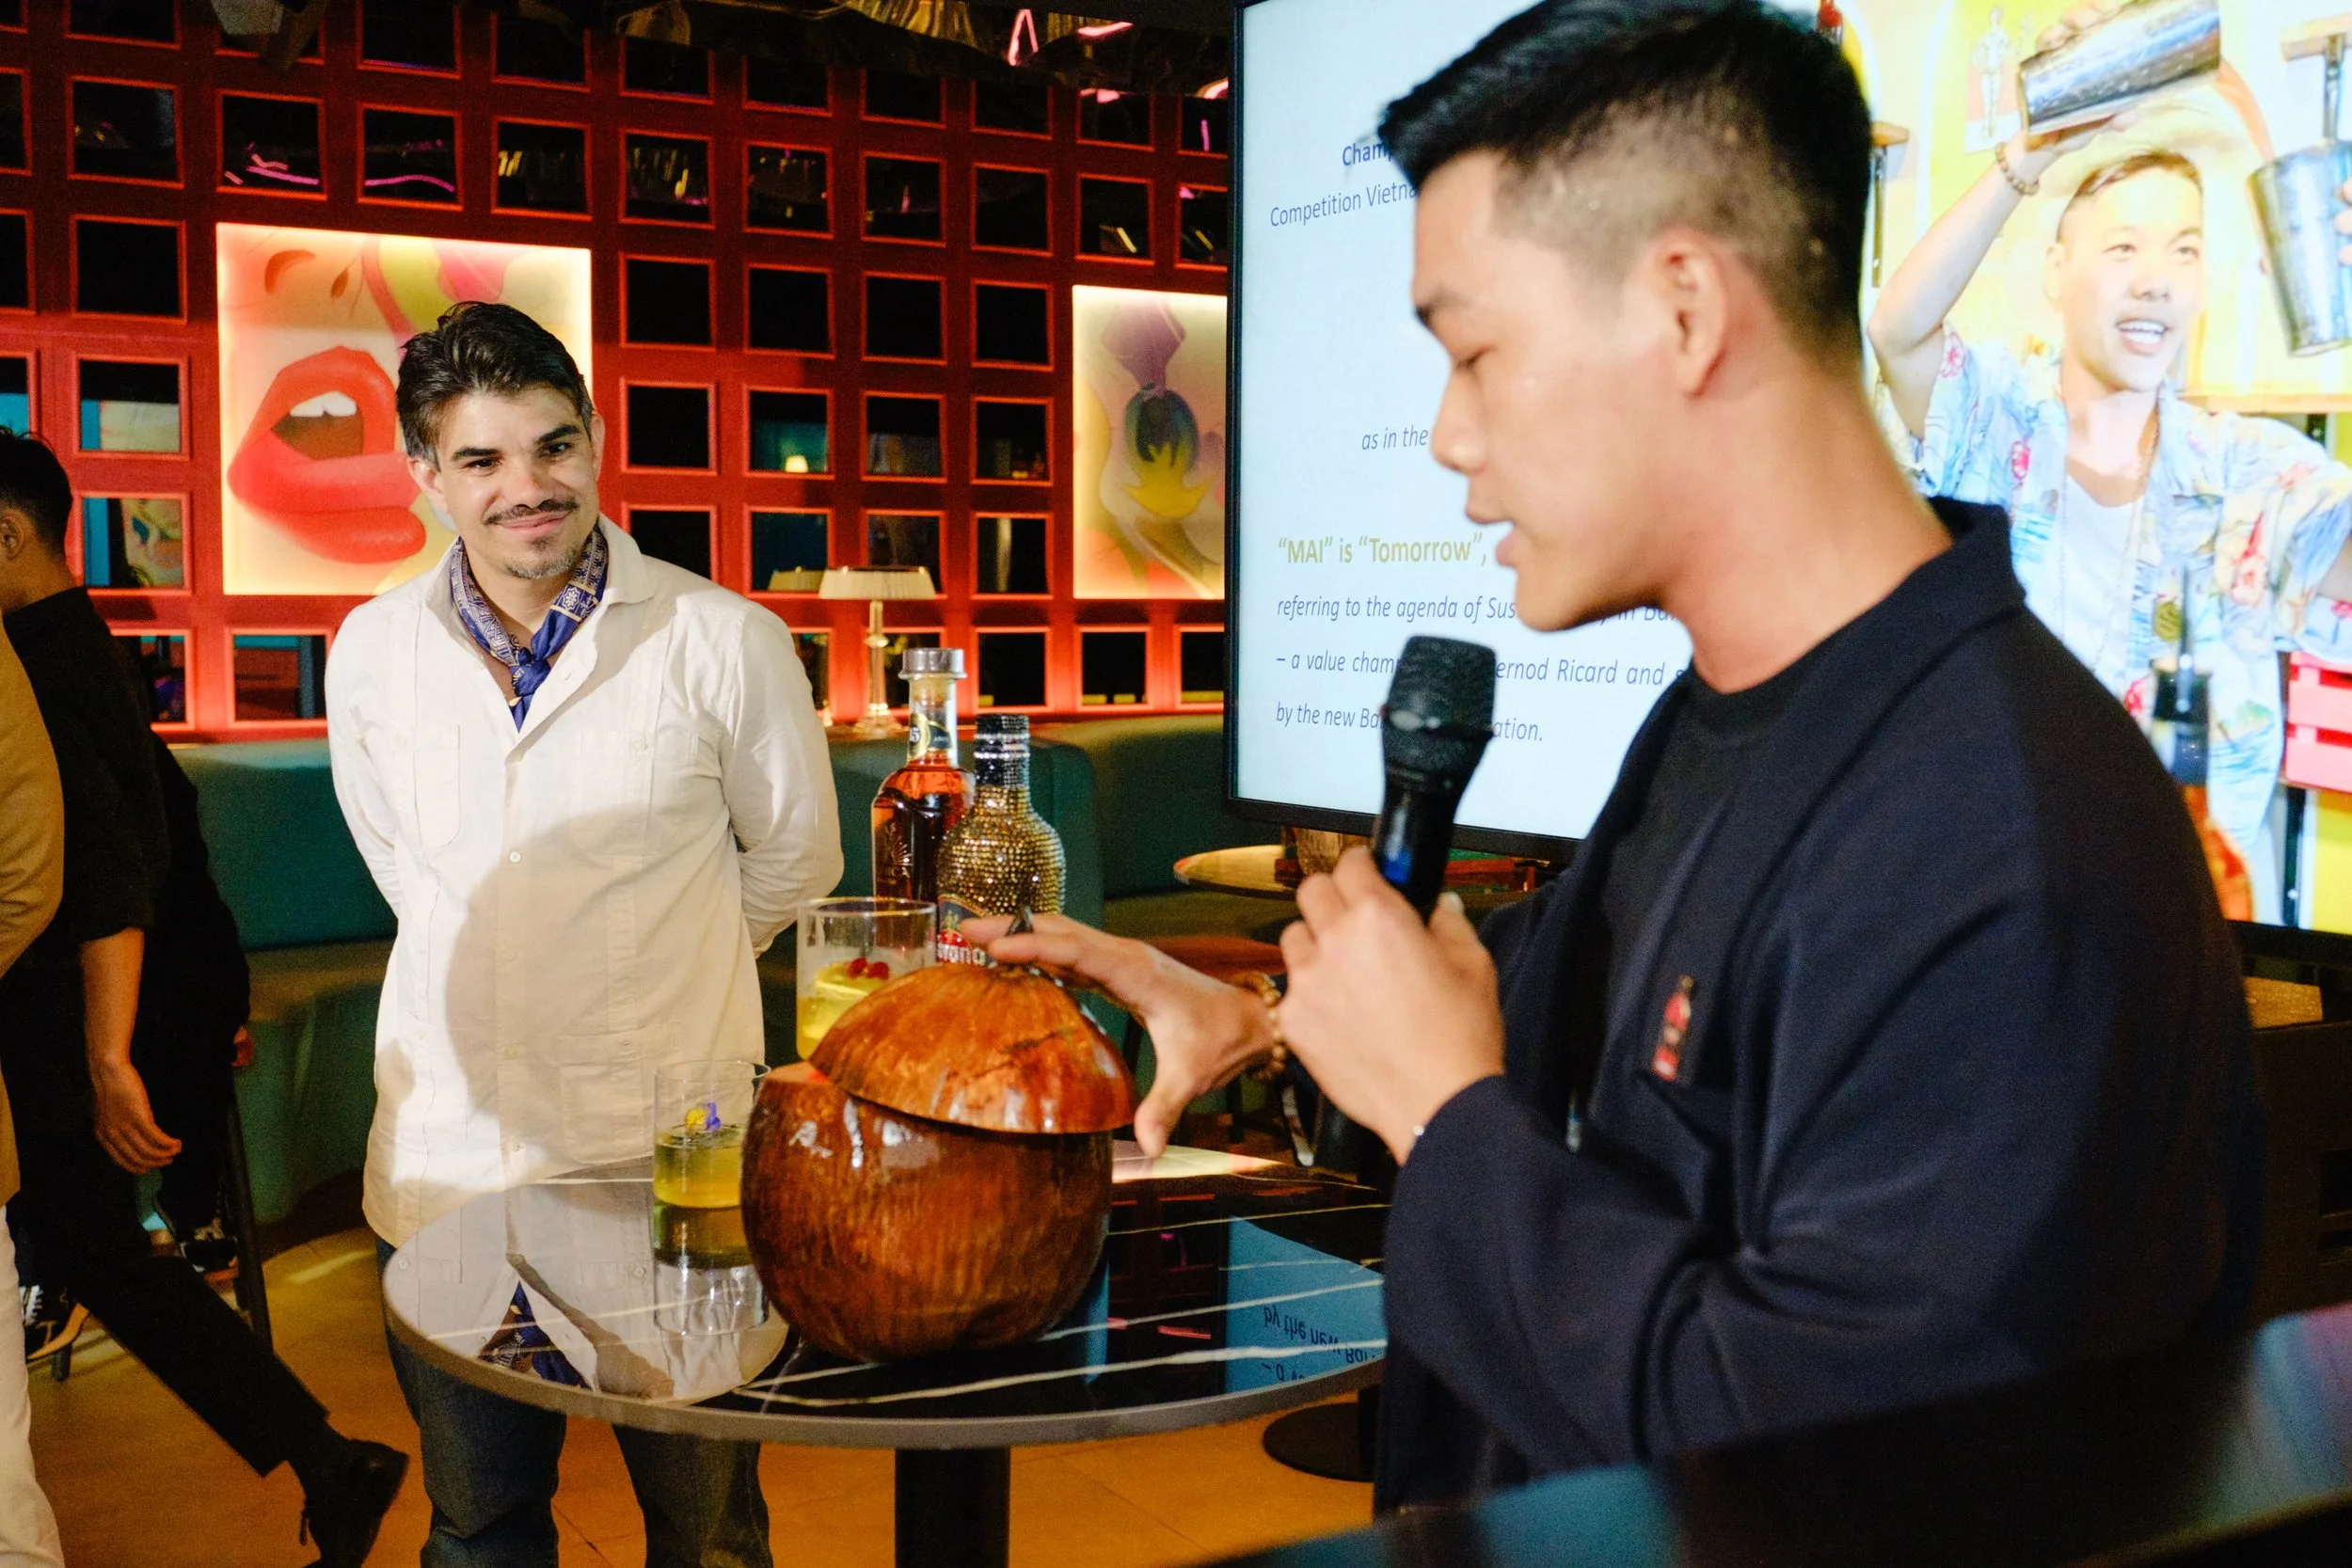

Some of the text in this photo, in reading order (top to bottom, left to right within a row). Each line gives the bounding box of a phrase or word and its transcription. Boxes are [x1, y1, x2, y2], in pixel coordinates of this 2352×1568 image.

[1270, 192, 1361, 227] Competition
[1361, 423, 1429, 451] as in the
[1278, 536, 1333, 563] “MAI”
[1339, 538, 1353, 563] is
[1277, 594, 1340, 622] referring
[1345, 599, 1361, 617] to
[1366, 595, 1391, 617] the
[1396, 595, 1458, 623] agenda
[1464, 595, 1484, 624] of
[1486, 597, 1517, 620] Sus
[1291, 654, 1300, 670] a
[1307, 649, 1346, 672] value
[1353, 650, 1395, 673] cham
[1495, 657, 1549, 680] ernod
[1557, 659, 1618, 684] Ricard
[1627, 662, 1665, 686] and
[1277, 701, 1294, 727] by
[1297, 703, 1321, 724] the
[1325, 709, 1356, 727] new
[1493, 718, 1543, 741] ation.
